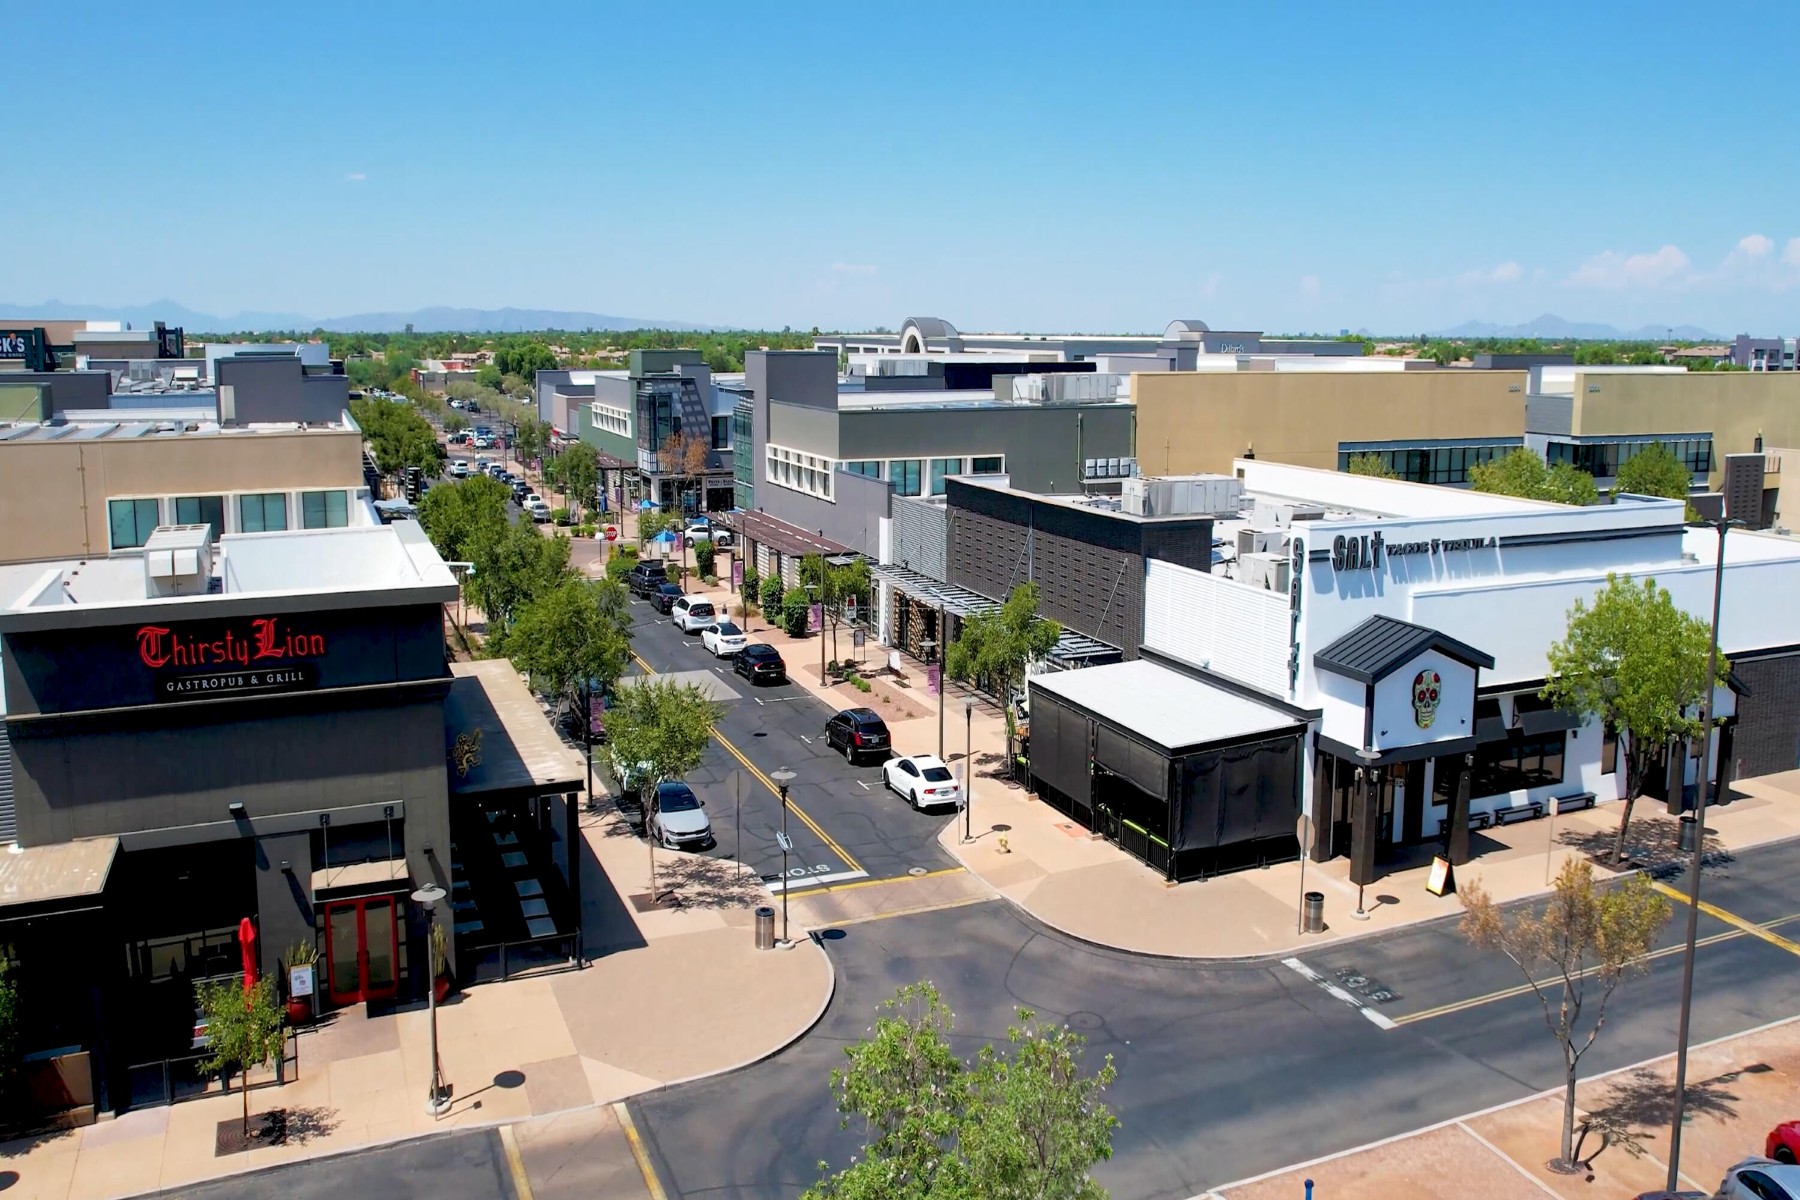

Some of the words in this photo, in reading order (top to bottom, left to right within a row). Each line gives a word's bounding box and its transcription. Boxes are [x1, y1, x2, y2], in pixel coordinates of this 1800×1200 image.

[0, 337, 26, 353] K'S
[1332, 530, 1384, 572] SALT
[1386, 542, 1430, 556] TACOS
[1441, 536, 1498, 552] TEQUILA
[1288, 537, 1304, 691] SALT
[136, 626, 249, 667] Thirsty
[252, 617, 325, 660] Lion
[166, 676, 244, 692] GASTROPUB
[250, 675, 259, 684] &
[266, 671, 305, 683] GRILL
[778, 864, 831, 881] STOP
